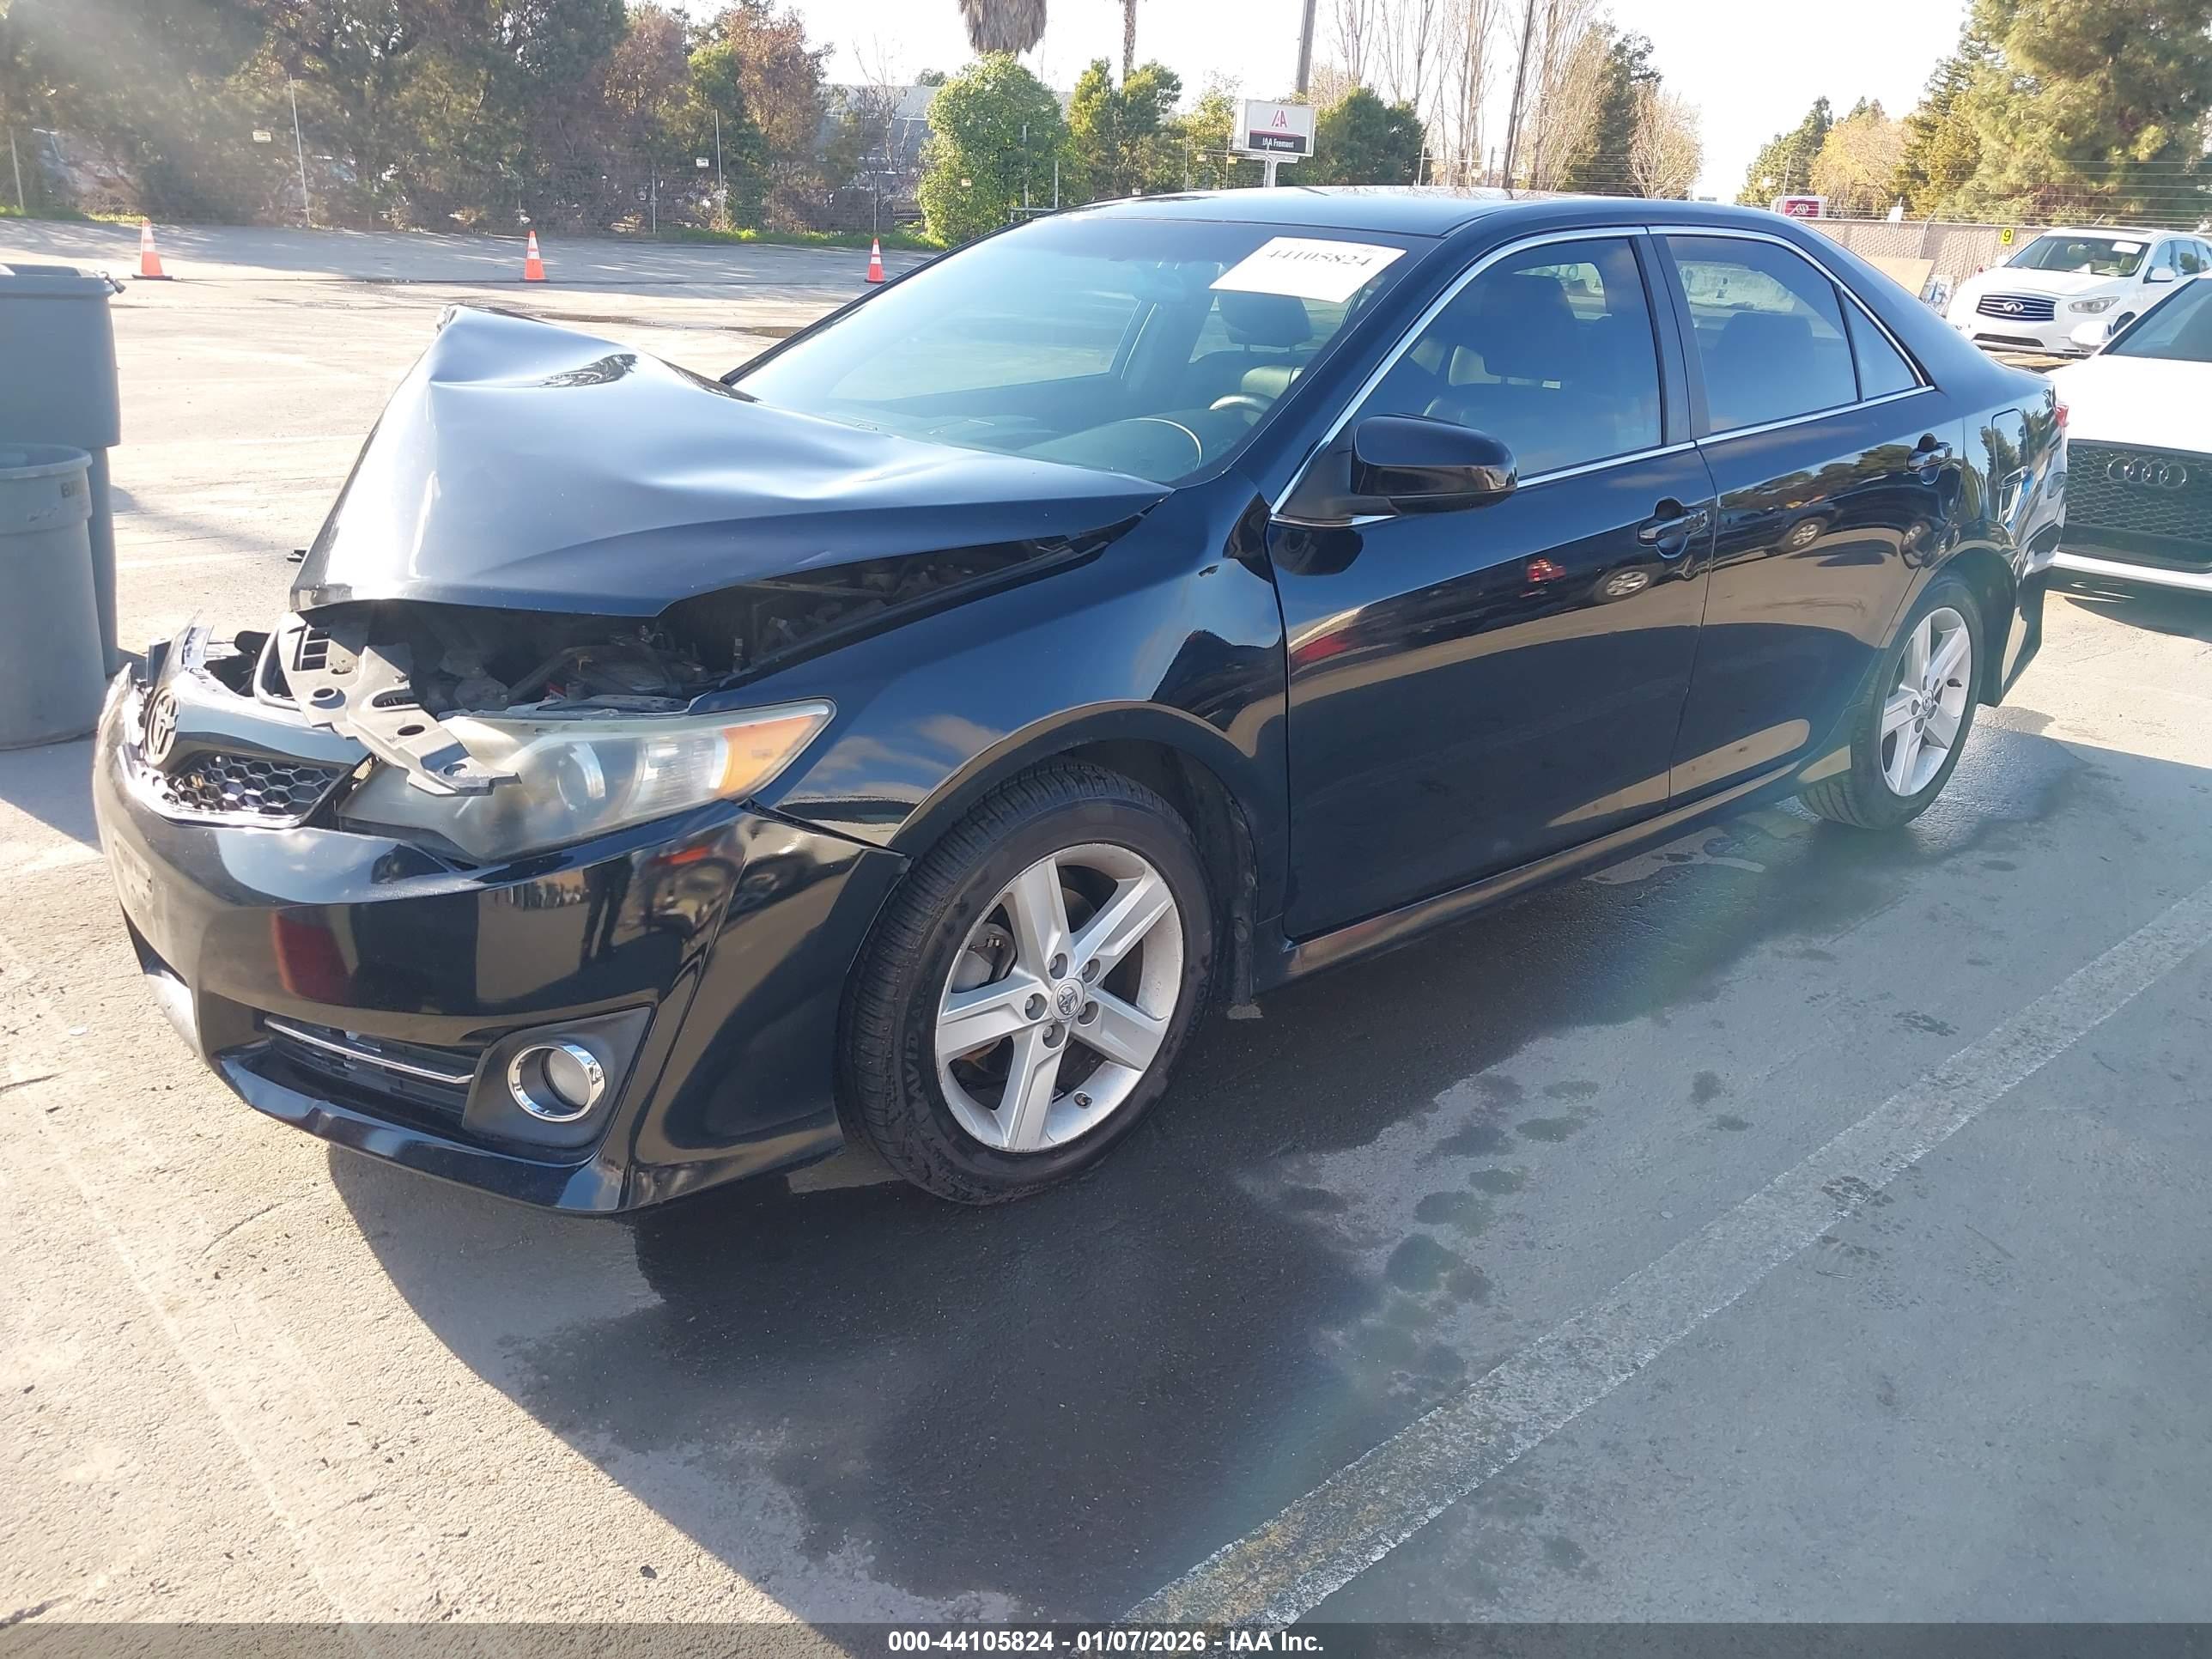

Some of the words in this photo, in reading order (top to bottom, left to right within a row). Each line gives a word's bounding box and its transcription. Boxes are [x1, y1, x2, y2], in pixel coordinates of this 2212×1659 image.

[1273, 138, 1294, 149] Fremont
[2003, 229, 2012, 241] 9
[1267, 250, 1372, 266] 44105824
